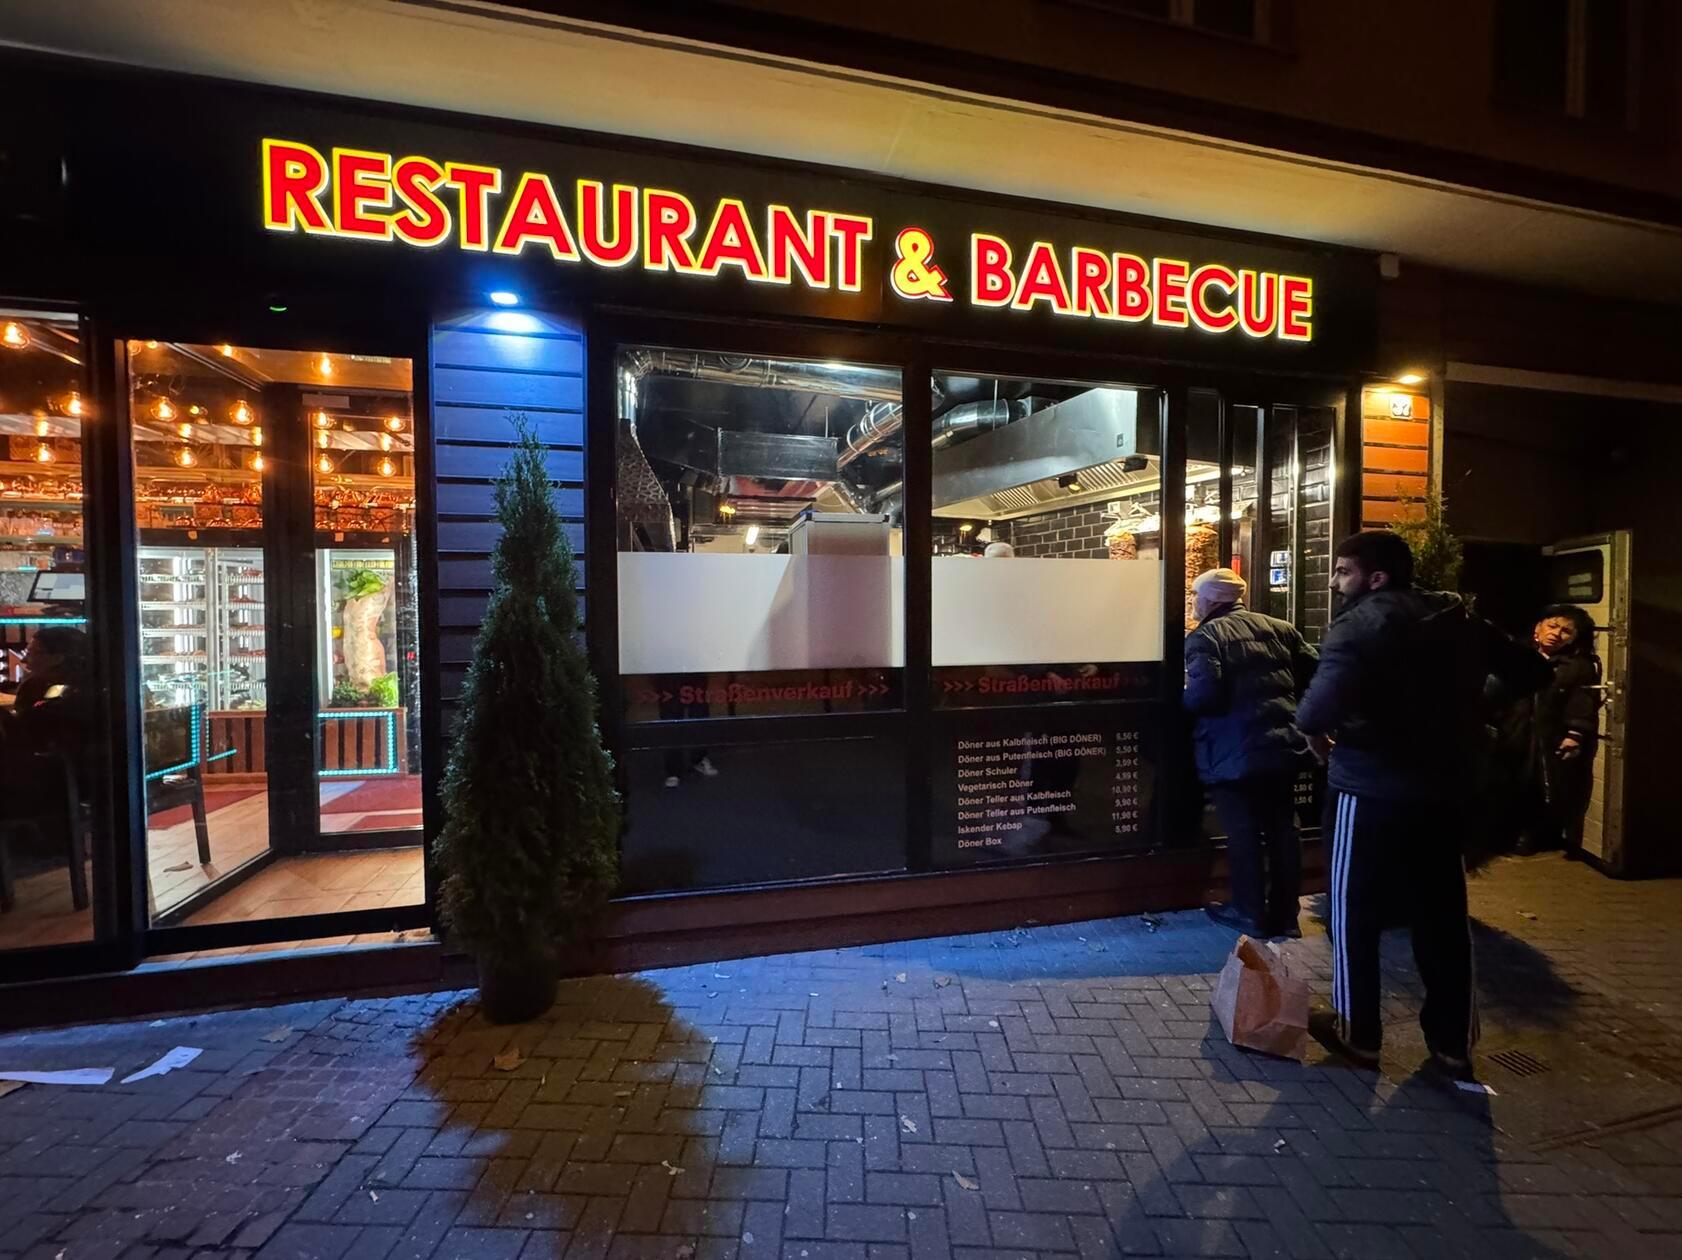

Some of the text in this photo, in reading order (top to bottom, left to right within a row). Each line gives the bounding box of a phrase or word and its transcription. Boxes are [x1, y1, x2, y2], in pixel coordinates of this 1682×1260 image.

[262, 138, 1313, 342] RESTAURANT & BARBECUE
[679, 681, 854, 705] Straßenverkauf
[958, 740, 984, 750] Döner
[985, 740, 1001, 748] aus
[1002, 737, 1048, 747] Kalbfleisch
[1049, 735, 1068, 746] (BIG
[1069, 733, 1102, 743] DÖNER)
[1133, 732, 1139, 740] €
[958, 754, 984, 764] Döner
[985, 754, 1001, 762] aus
[1002, 750, 1053, 761] Putenfleisch
[1054, 748, 1073, 759] (BIG
[1074, 746, 1106, 756] DÖNER)
[1133, 745, 1139, 753] €
[958, 769, 984, 778] Döner
[1133, 758, 1138, 766] €
[957, 780, 1007, 793] Vegetarisch
[1008, 778, 1034, 788] Döner
[1132, 771, 1138, 779] €
[958, 797, 984, 806] Döner
[986, 795, 1009, 804] Teller
[1010, 794, 1025, 802] aus
[1027, 790, 1071, 801] Kalbfleisch
[1132, 784, 1138, 793] €
[958, 811, 984, 820] Döner
[986, 809, 1008, 818] Teller
[1010, 808, 1025, 816] aus
[1027, 803, 1076, 814] Putenfleisch
[1132, 798, 1138, 806] €
[958, 823, 994, 834] Iskender
[996, 821, 1023, 831] Kebap
[1132, 811, 1138, 819] €
[958, 839, 984, 848] Döner
[985, 837, 1002, 846] Box
[1132, 824, 1138, 832] €
